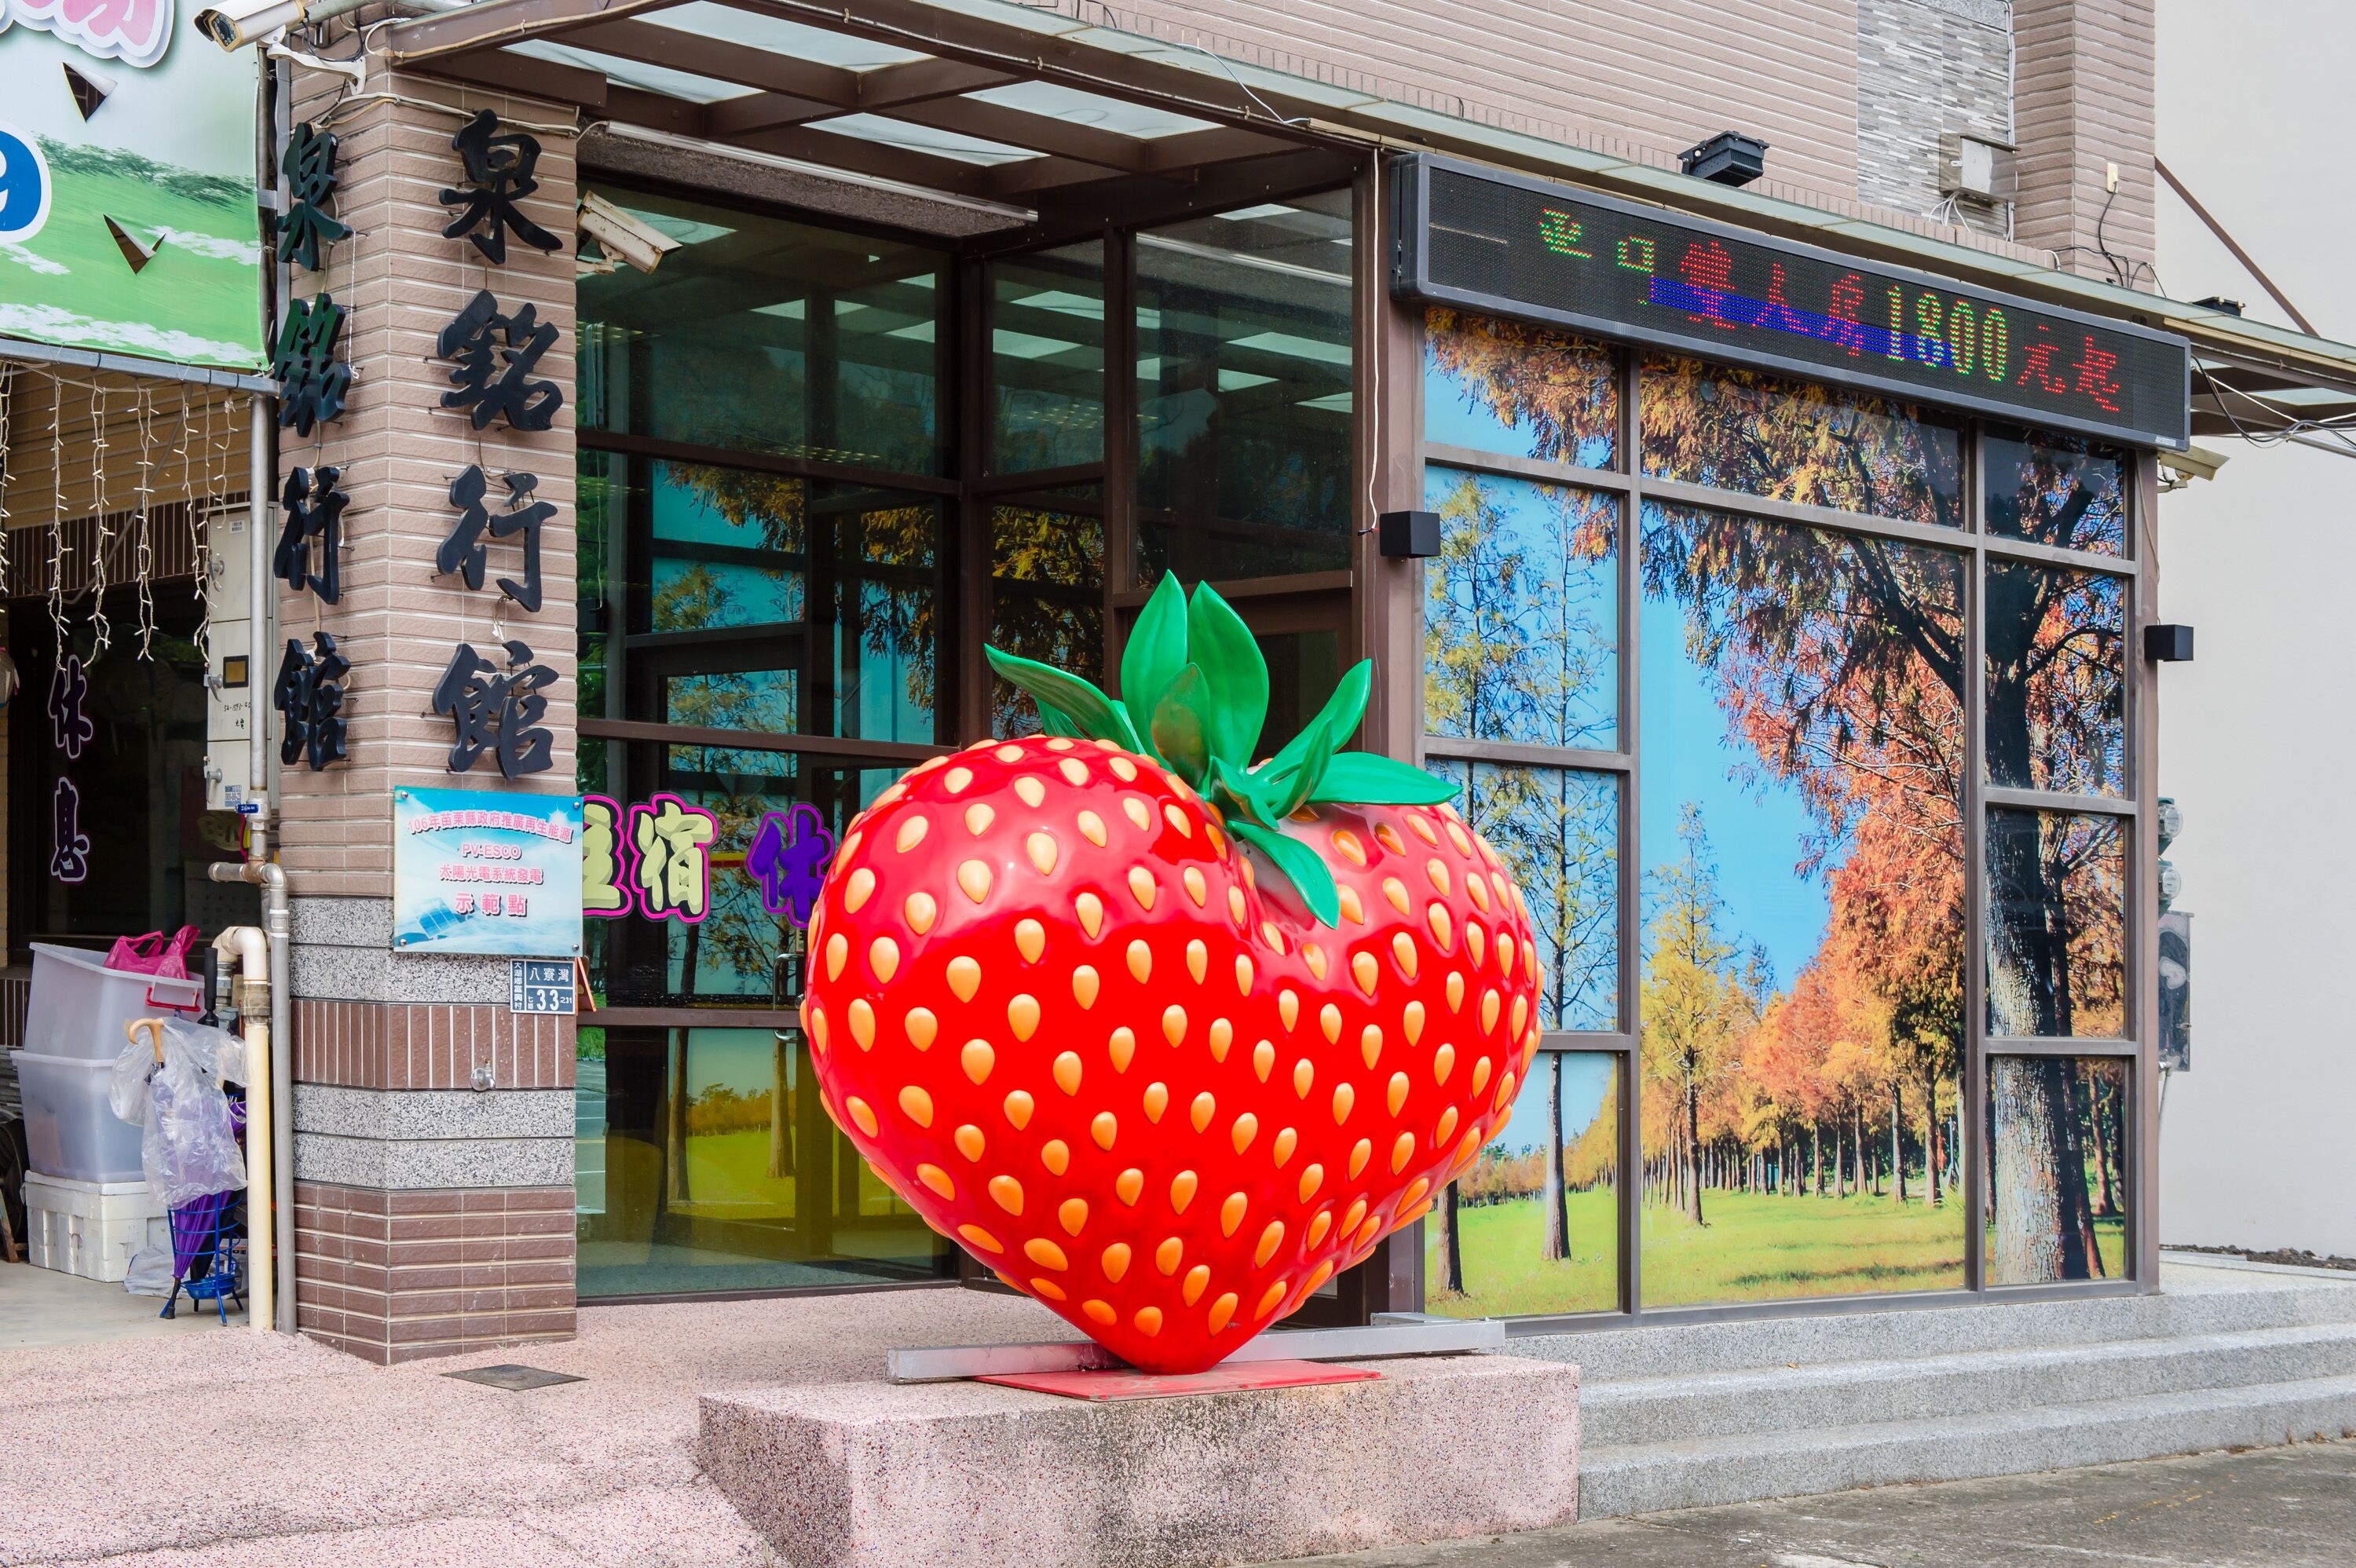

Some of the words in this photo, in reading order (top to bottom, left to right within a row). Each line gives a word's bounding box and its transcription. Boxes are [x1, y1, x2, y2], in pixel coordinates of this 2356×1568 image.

[432, 108, 564, 780] 泉銘行館
[408, 810, 574, 843] 106年苗栗縣政府推廣再生能源
[439, 864, 543, 883] 太陽光電系統發電
[455, 893, 527, 916] 示範點
[529, 967, 569, 982] 八寮灣
[536, 989, 559, 1011] 33
